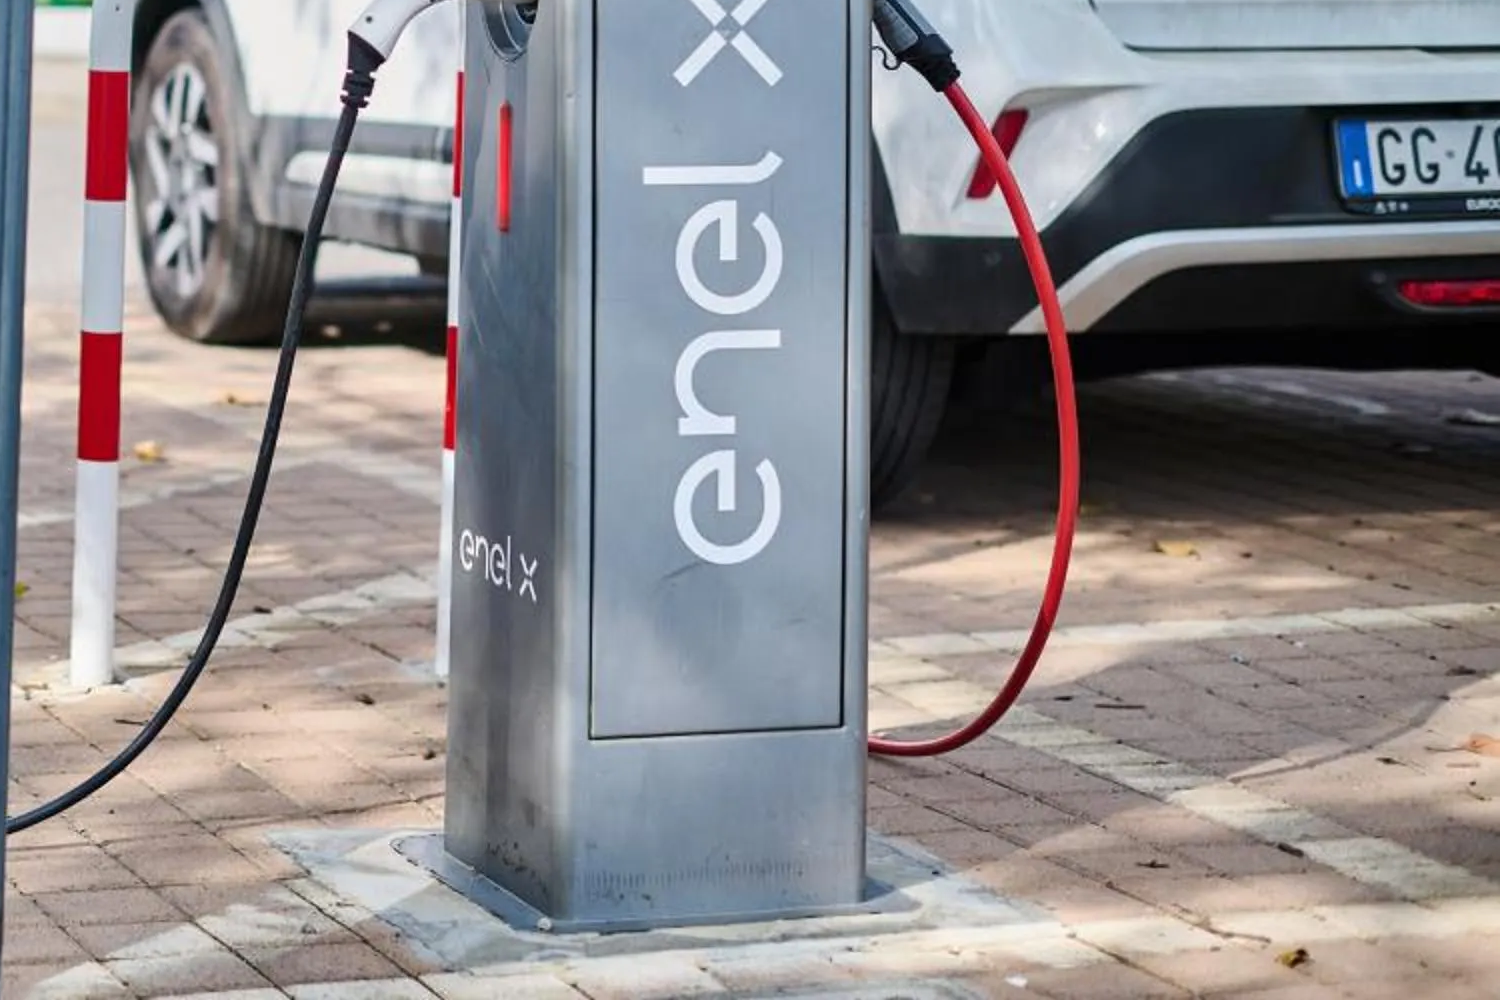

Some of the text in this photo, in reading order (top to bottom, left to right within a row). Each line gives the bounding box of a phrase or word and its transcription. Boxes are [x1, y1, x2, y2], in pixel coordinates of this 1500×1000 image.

[1464, 124, 1500, 185] 4
[642, 150, 784, 565] enel
[460, 528, 512, 591] enel
